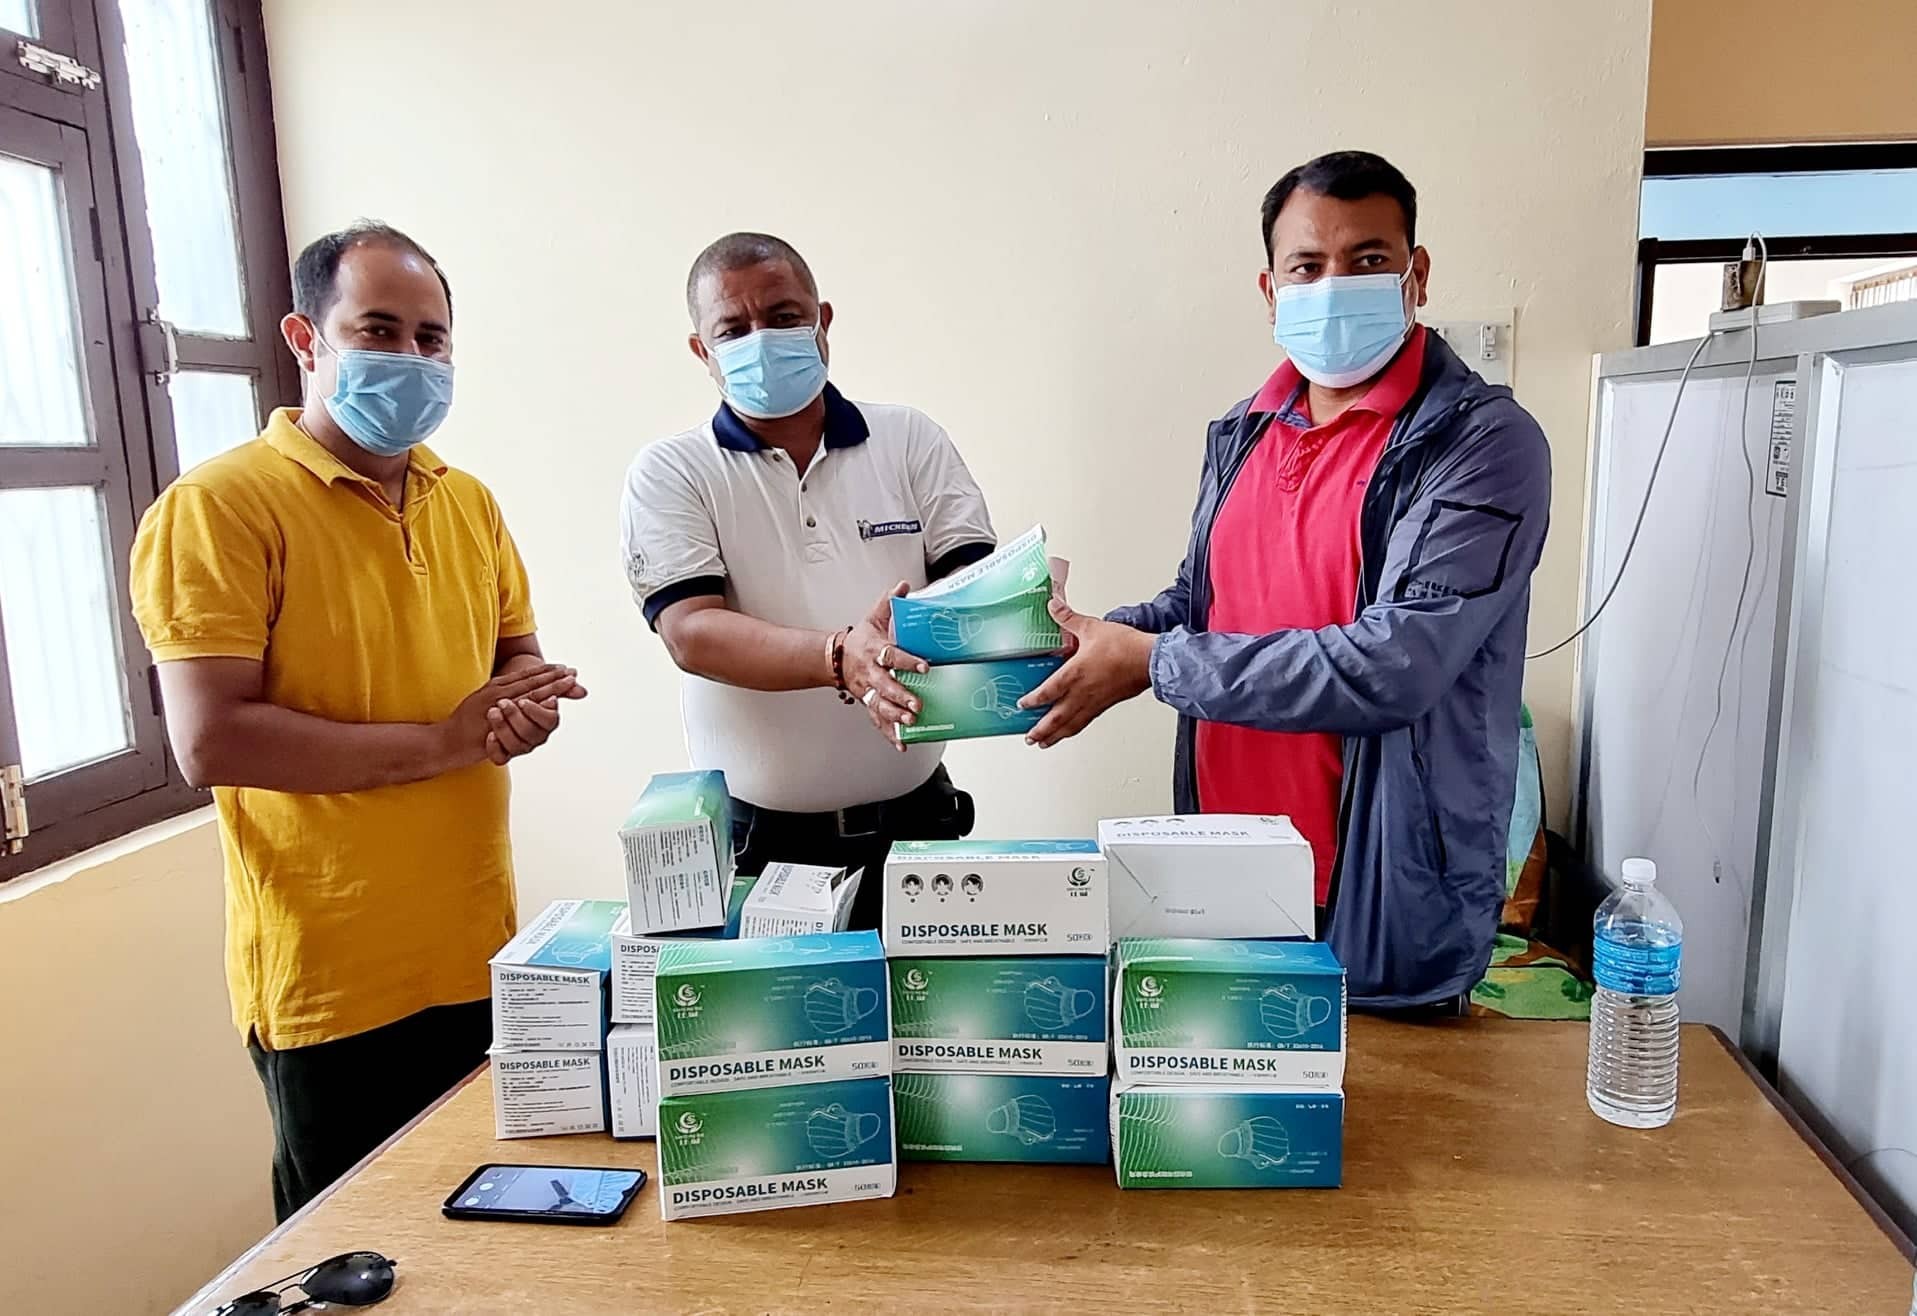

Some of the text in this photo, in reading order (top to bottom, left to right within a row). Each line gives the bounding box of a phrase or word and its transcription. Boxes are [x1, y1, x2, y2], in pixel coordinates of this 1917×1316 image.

[901, 923, 1048, 938] DISPOSABLE MASK
[620, 944, 660, 954] DISPOS
[499, 972, 591, 985] DISPOSABLE MASK
[898, 1044, 1042, 1059] DISPOSABLE MASK
[499, 1057, 591, 1070] DISPOSABLE MASK
[669, 1055, 825, 1081] DISPOSABLE MASK
[1129, 1055, 1277, 1071] DISPOSABLE MASK
[673, 1181, 777, 1205] DISPOSABLE
[782, 1177, 828, 1193] MASK
